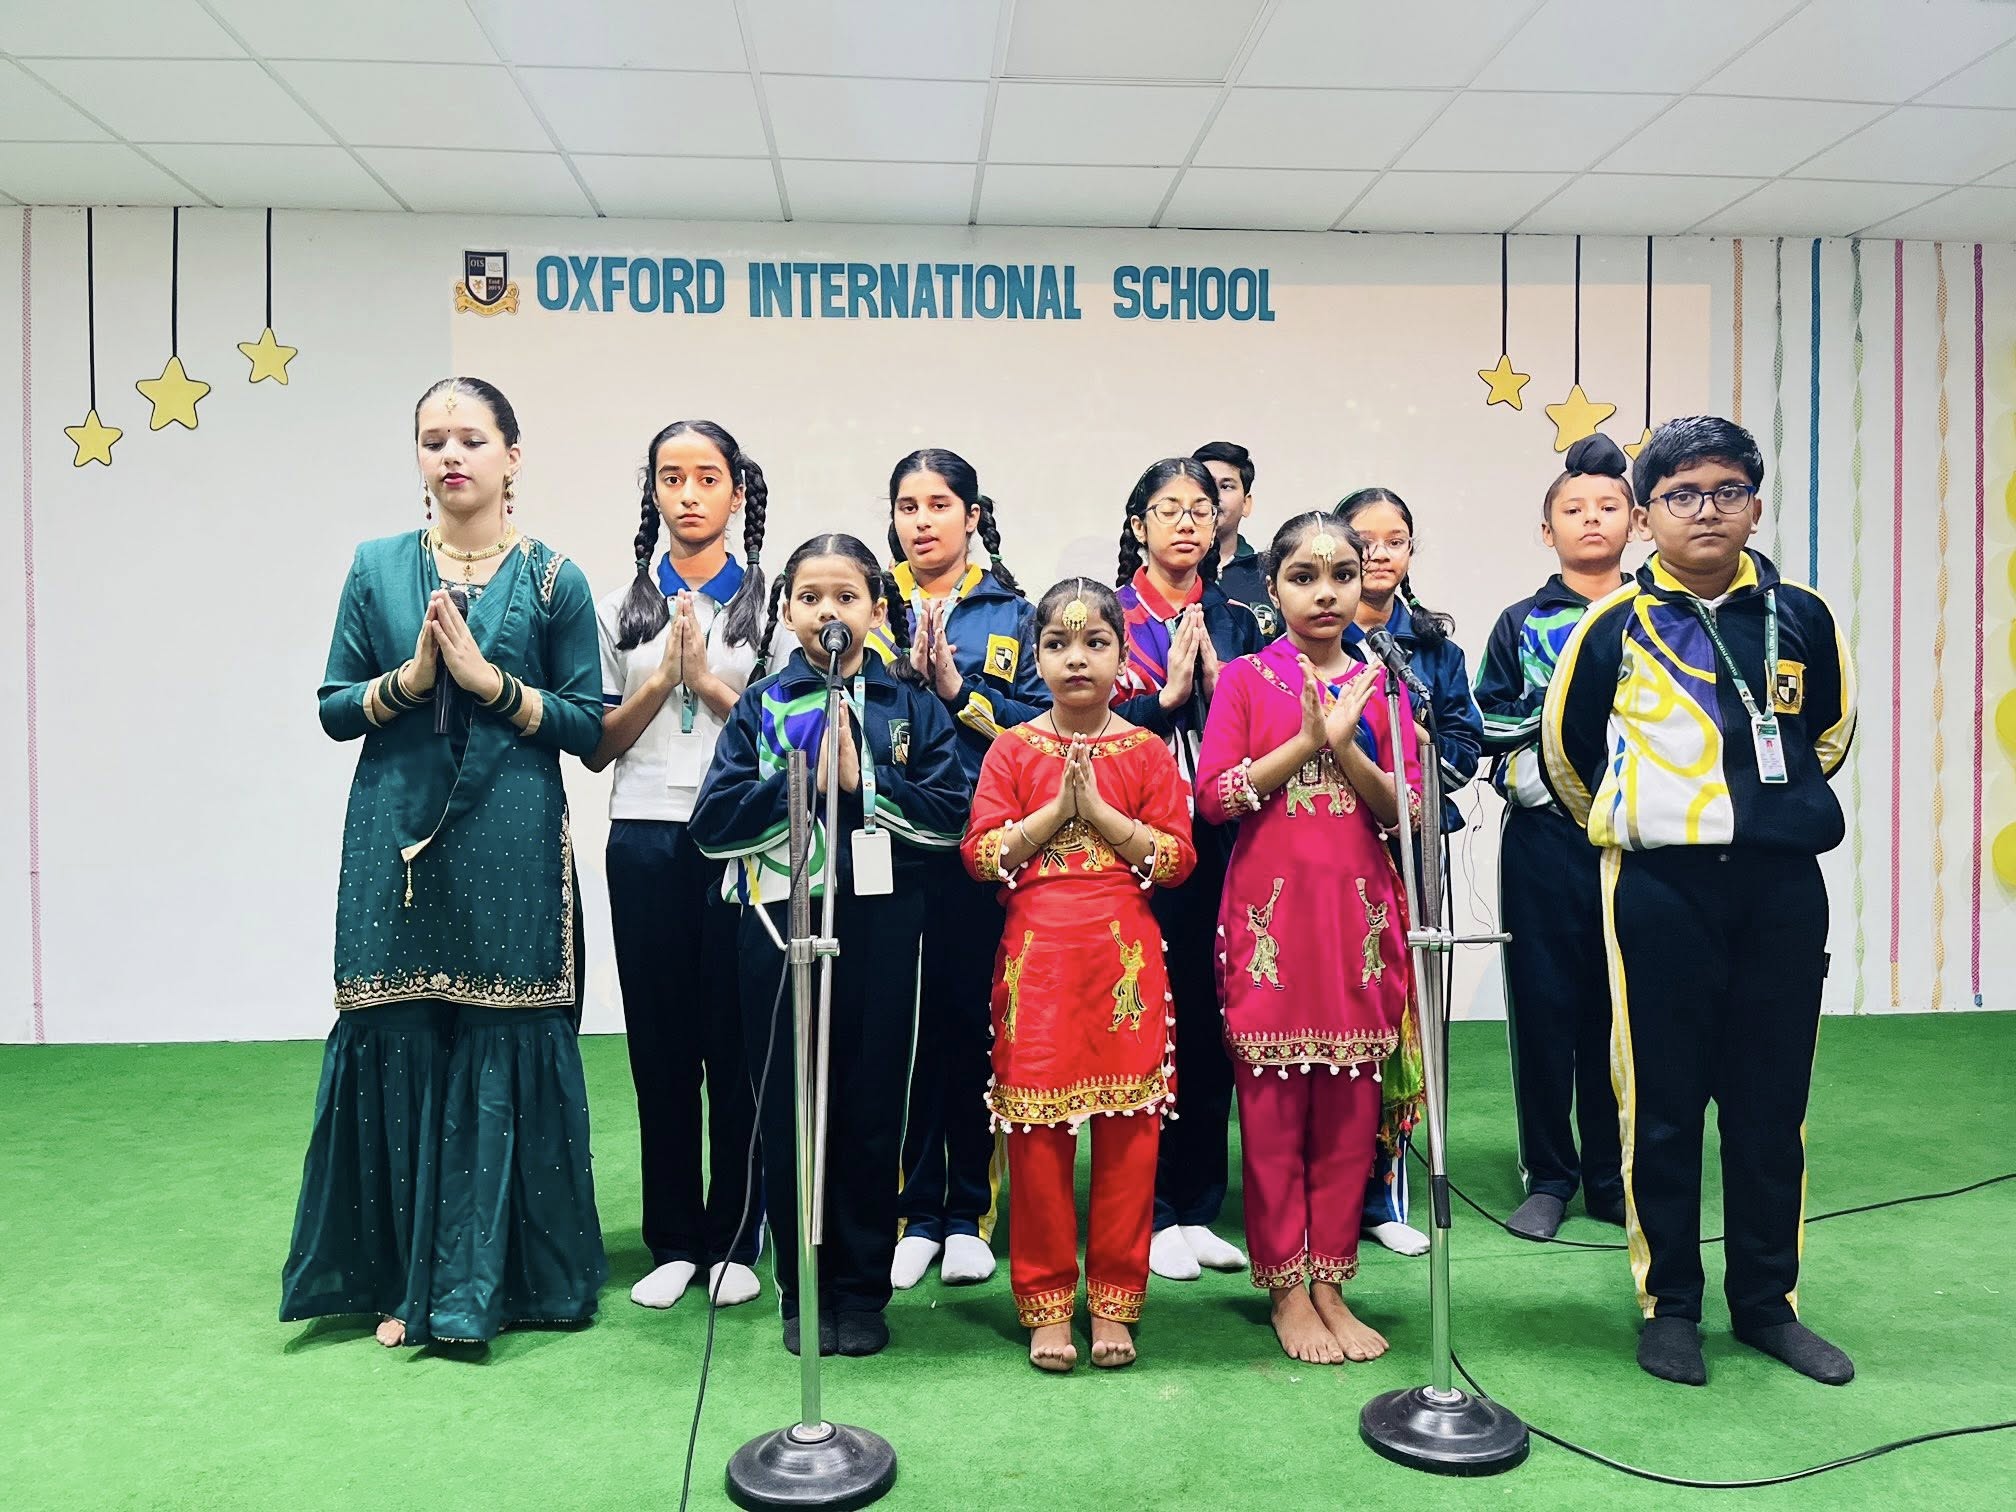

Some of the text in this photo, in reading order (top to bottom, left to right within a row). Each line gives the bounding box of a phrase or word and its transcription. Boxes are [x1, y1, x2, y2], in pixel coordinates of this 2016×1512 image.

[470, 259, 485, 268] OIS
[536, 255, 1275, 321] OXFORD INTERNATIONAL SCHOOL
